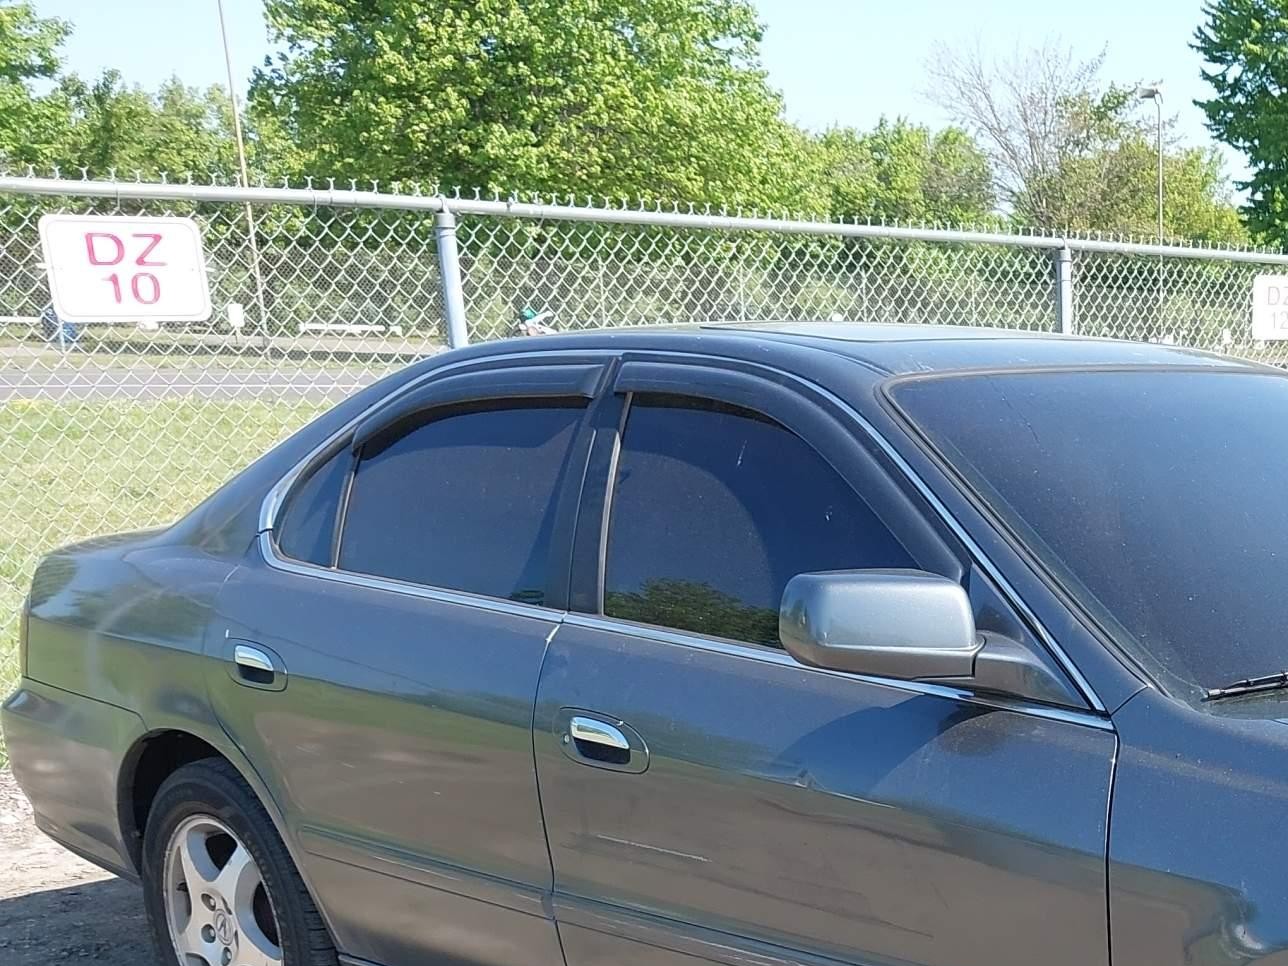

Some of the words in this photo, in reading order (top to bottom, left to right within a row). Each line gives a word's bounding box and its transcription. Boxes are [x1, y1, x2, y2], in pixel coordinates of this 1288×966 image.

[85, 232, 167, 266] DZ
[102, 272, 161, 304] 10
[1271, 310, 1288, 330] 12
